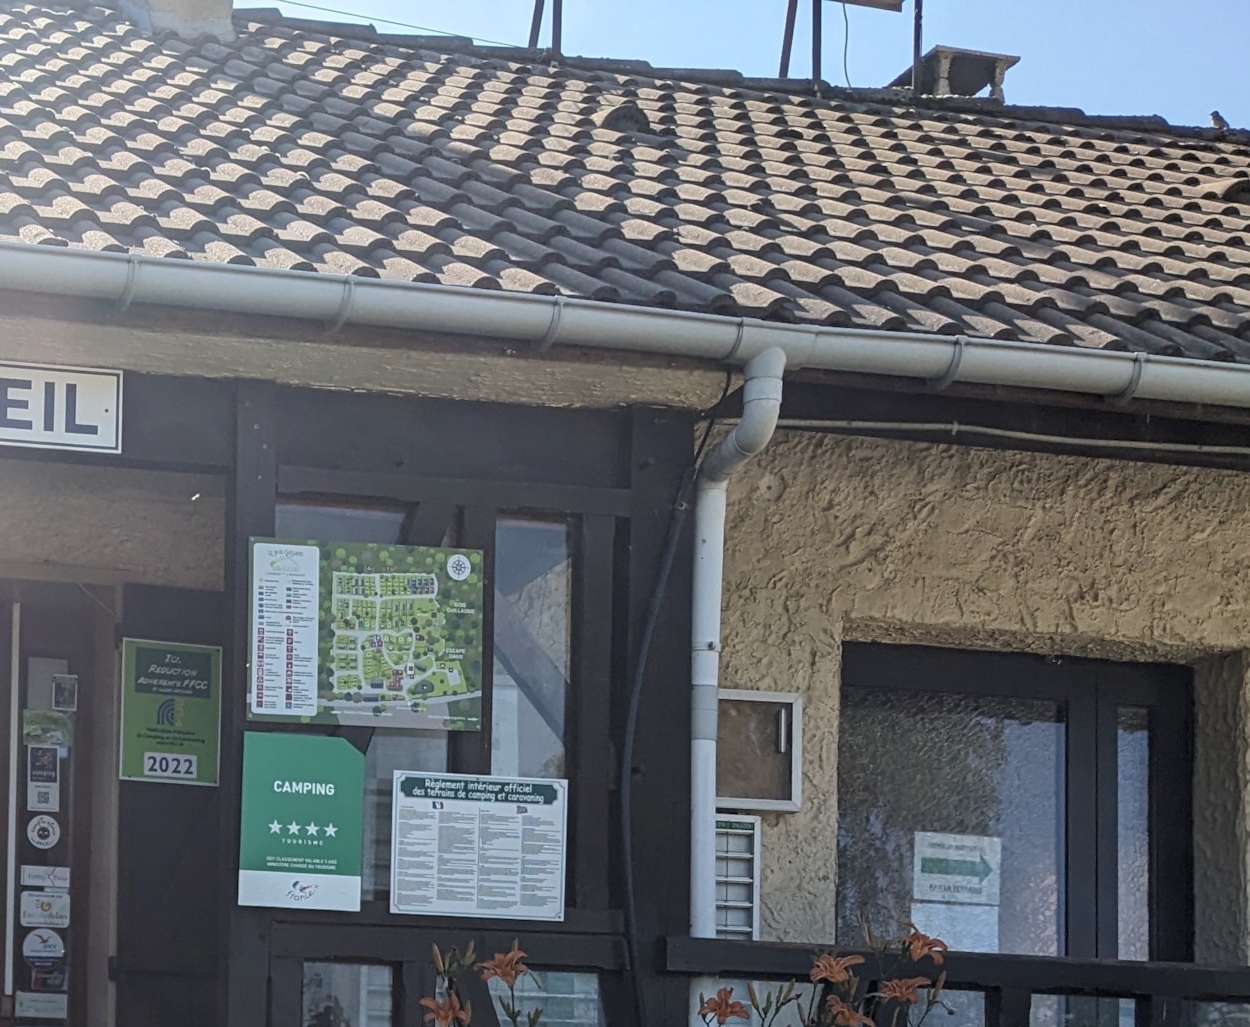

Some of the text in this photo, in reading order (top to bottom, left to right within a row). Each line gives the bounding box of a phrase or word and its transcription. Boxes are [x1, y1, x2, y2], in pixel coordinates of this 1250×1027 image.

[147, 756, 194, 775] 2022
[273, 780, 335, 796] CAMPING
[424, 778, 533, 793] Règlement intérieur officiel
[412, 787, 545, 805] des terrains de camping et caravaning
